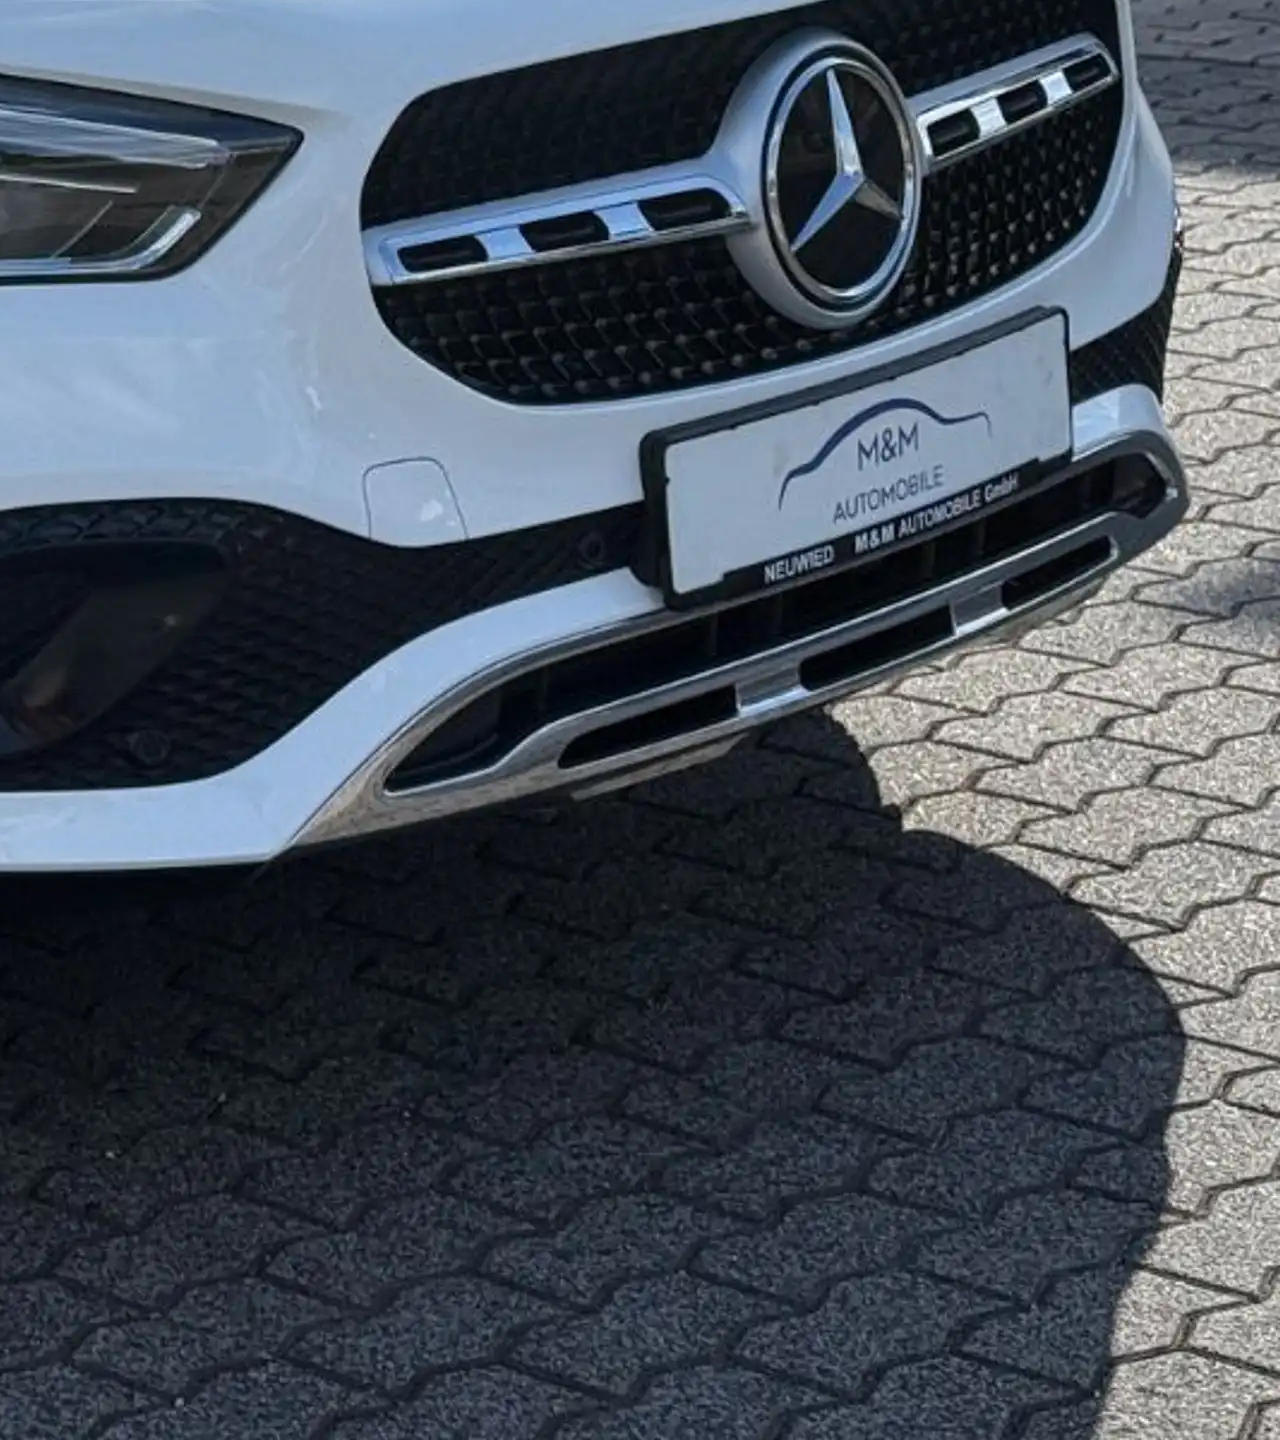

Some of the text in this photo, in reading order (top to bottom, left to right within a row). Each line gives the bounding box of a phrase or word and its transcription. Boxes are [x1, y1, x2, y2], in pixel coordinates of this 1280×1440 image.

[856, 422, 920, 471] M&M
[832, 464, 945, 524] AUTOMOBILE
[764, 471, 1020, 585] NEUWIED M&M AUTOMOBILE GmbH
